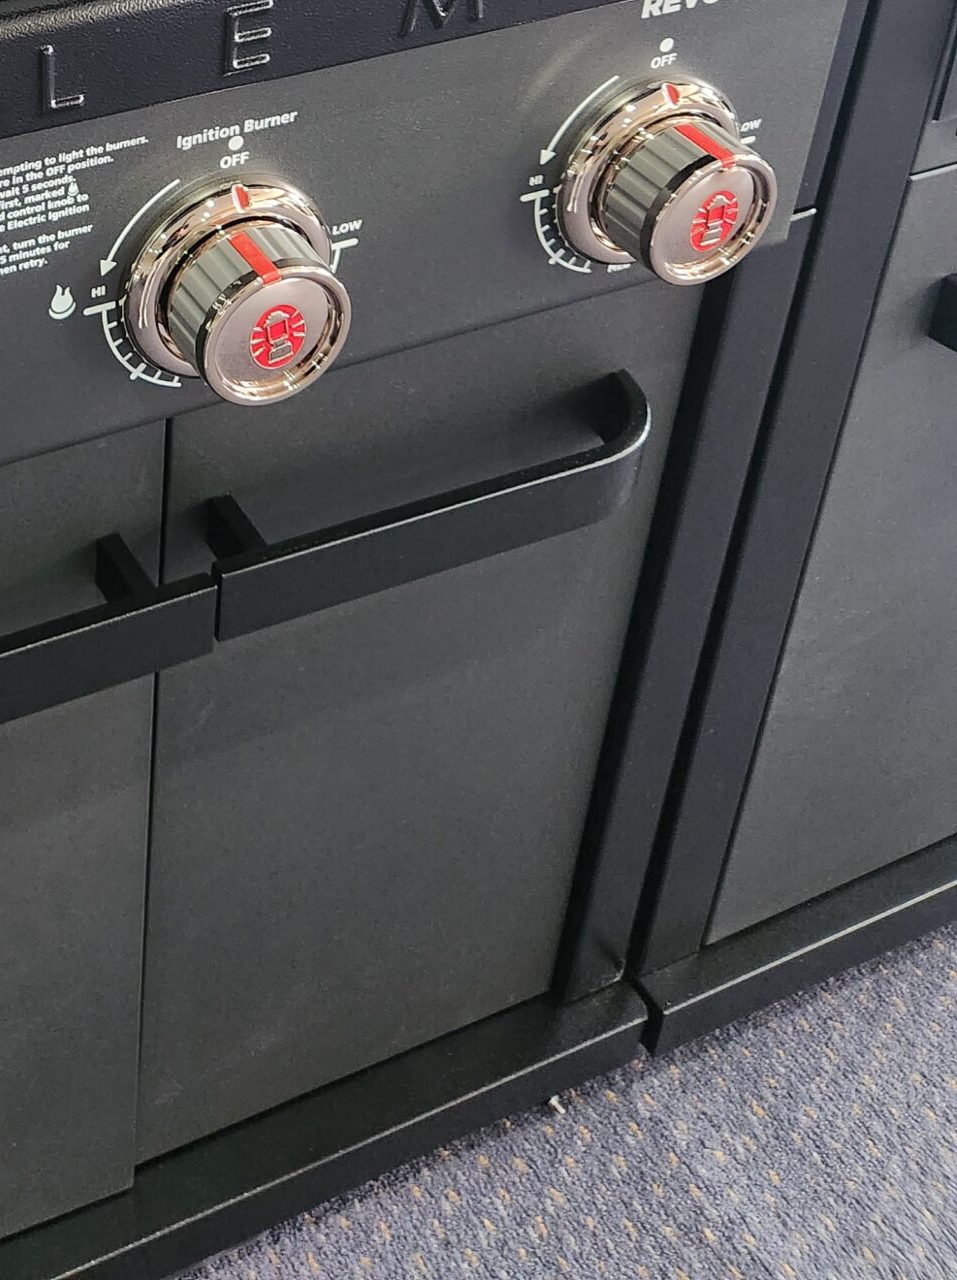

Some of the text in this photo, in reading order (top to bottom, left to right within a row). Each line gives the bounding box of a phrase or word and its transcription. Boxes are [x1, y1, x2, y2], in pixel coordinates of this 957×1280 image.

[650, 53, 677, 69] OFF
[176, 111, 298, 151] Ignition Burner
[740, 118, 762, 132] OW
[44, 156, 57, 166] to
[58, 148, 84, 164] light
[85, 146, 104, 157] the
[105, 136, 149, 152] burners.
[219, 151, 250, 169] OFF
[11, 174, 23, 185] in
[25, 170, 44, 182] the
[45, 164, 66, 177] OFF
[67, 155, 114, 174] position.
[22, 184, 29, 194] 5
[31, 174, 77, 192] seconds.
[529, 175, 543, 187] HI
[24, 186, 65, 204] marked
[7, 202, 46, 219] control
[47, 196, 75, 210] knob
[76, 193, 89, 203] to
[7, 214, 47, 230] Electric
[48, 204, 90, 221] Ignition
[12, 238, 36, 250] turn
[37, 233, 56, 244] the
[57, 224, 93, 240] burner
[331, 219, 363, 236] LOW
[0, 255, 7, 265] 5
[8, 245, 52, 263] minutes
[53, 240, 70, 251] for
[18, 257, 49, 271] retry.
[91, 285, 107, 299] HI
